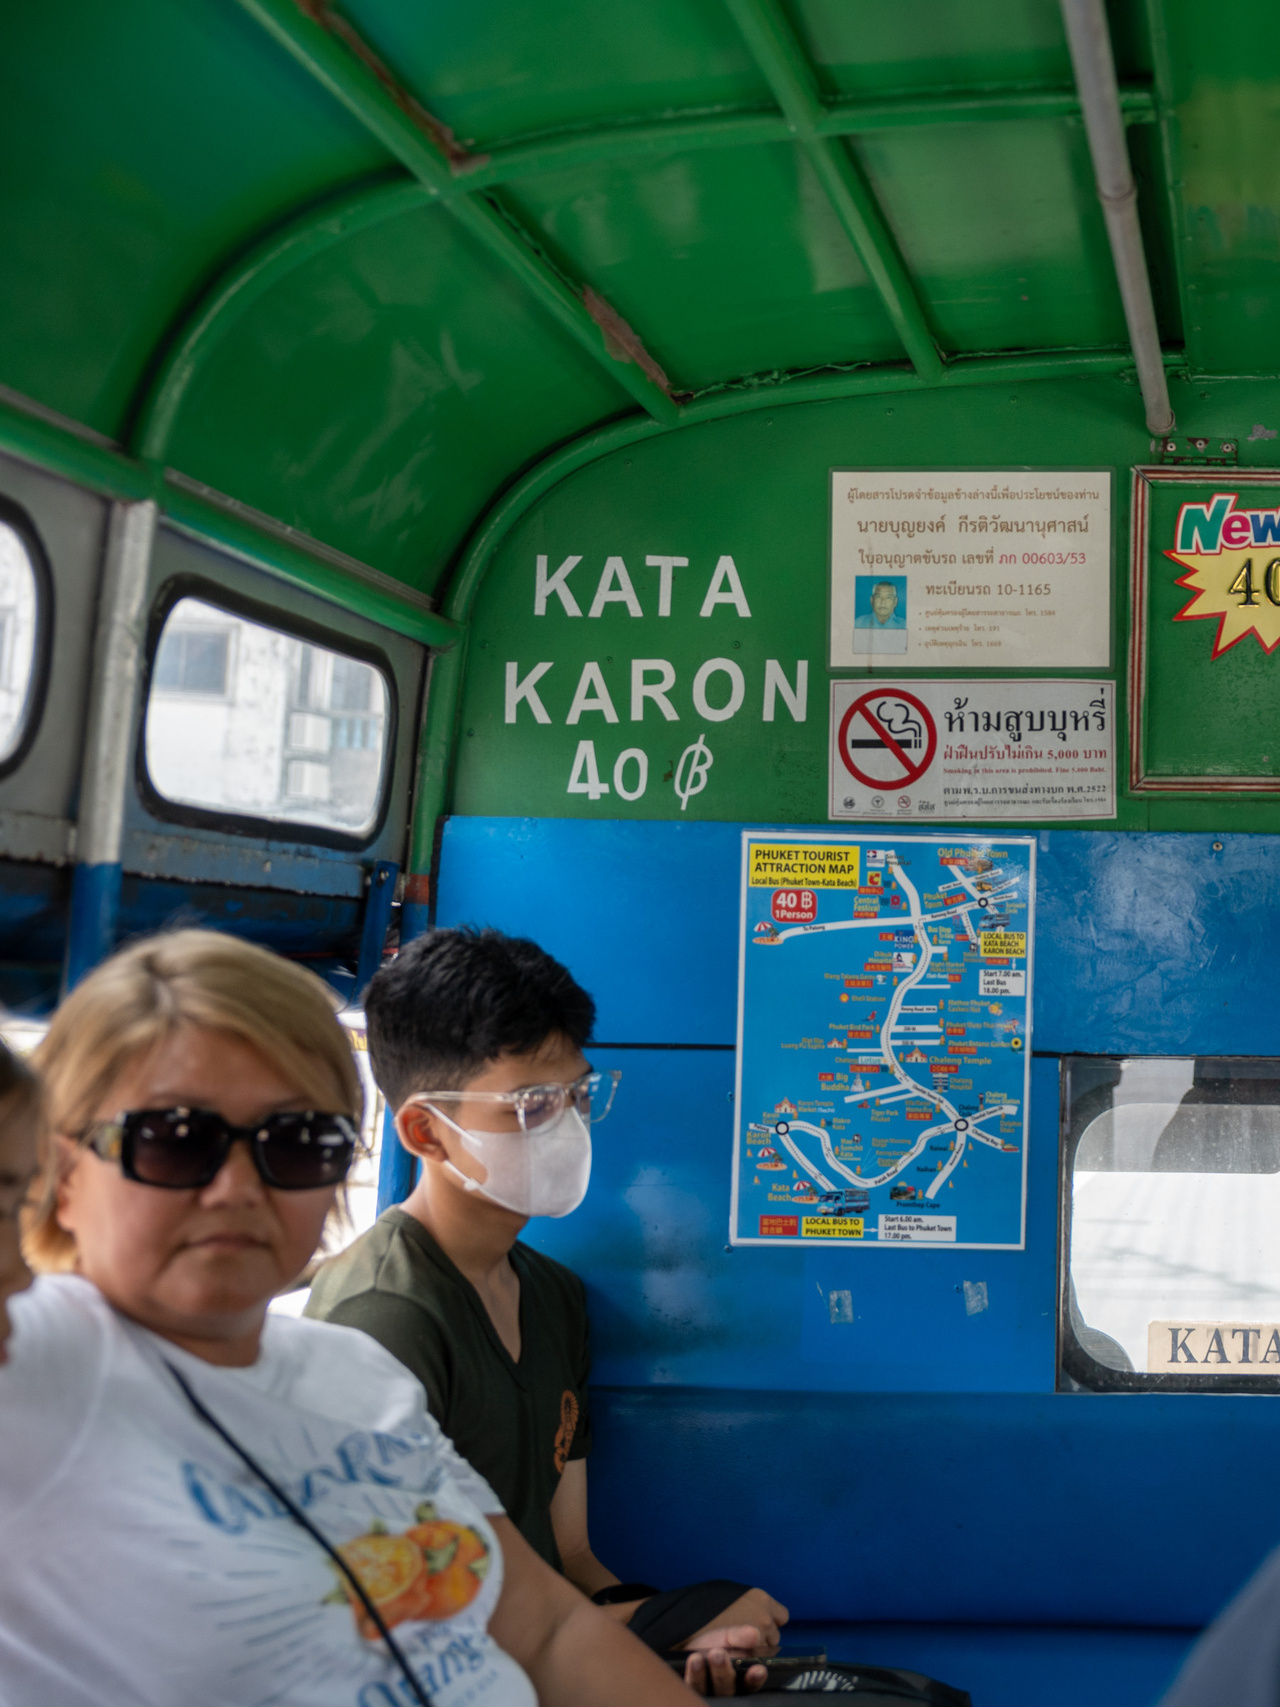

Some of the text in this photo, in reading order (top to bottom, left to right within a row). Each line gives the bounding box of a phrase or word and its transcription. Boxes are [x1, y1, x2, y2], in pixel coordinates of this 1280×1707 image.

[962, 546, 995, 565] เลขที่
[1021, 551, 1087, 566] 00603/53
[534, 554, 753, 618] KATA
[998, 583, 1052, 597] 10-1165
[504, 657, 809, 725] KARON
[944, 688, 1106, 742] ห้ามสูบบุหรี่
[1047, 749, 1079, 761] 5,000
[1084, 748, 1107, 760] บาท
[566, 739, 649, 801] 40
[755, 849, 851, 863] PHUKET TOURIST
[937, 848, 953, 857] Old
[754, 862, 855, 875] ATTRACTION MAP
[751, 876, 858, 889] Local Bus (Phuket Town-Kata Beach)
[776, 892, 798, 908] 40
[854, 896, 879, 905] Central
[854, 904, 881, 913] Festival
[894, 935, 915, 943] KING
[929, 1056, 992, 1065] Chalong Temple
[836, 1072, 849, 1083] Big
[821, 1082, 850, 1091] Buddha
[746, 1137, 772, 1145] Beach
[772, 1183, 790, 1191] Kata
[767, 1192, 792, 1201] Beach
[805, 1217, 830, 1225] LOCAL
[849, 1218, 860, 1226] TO
